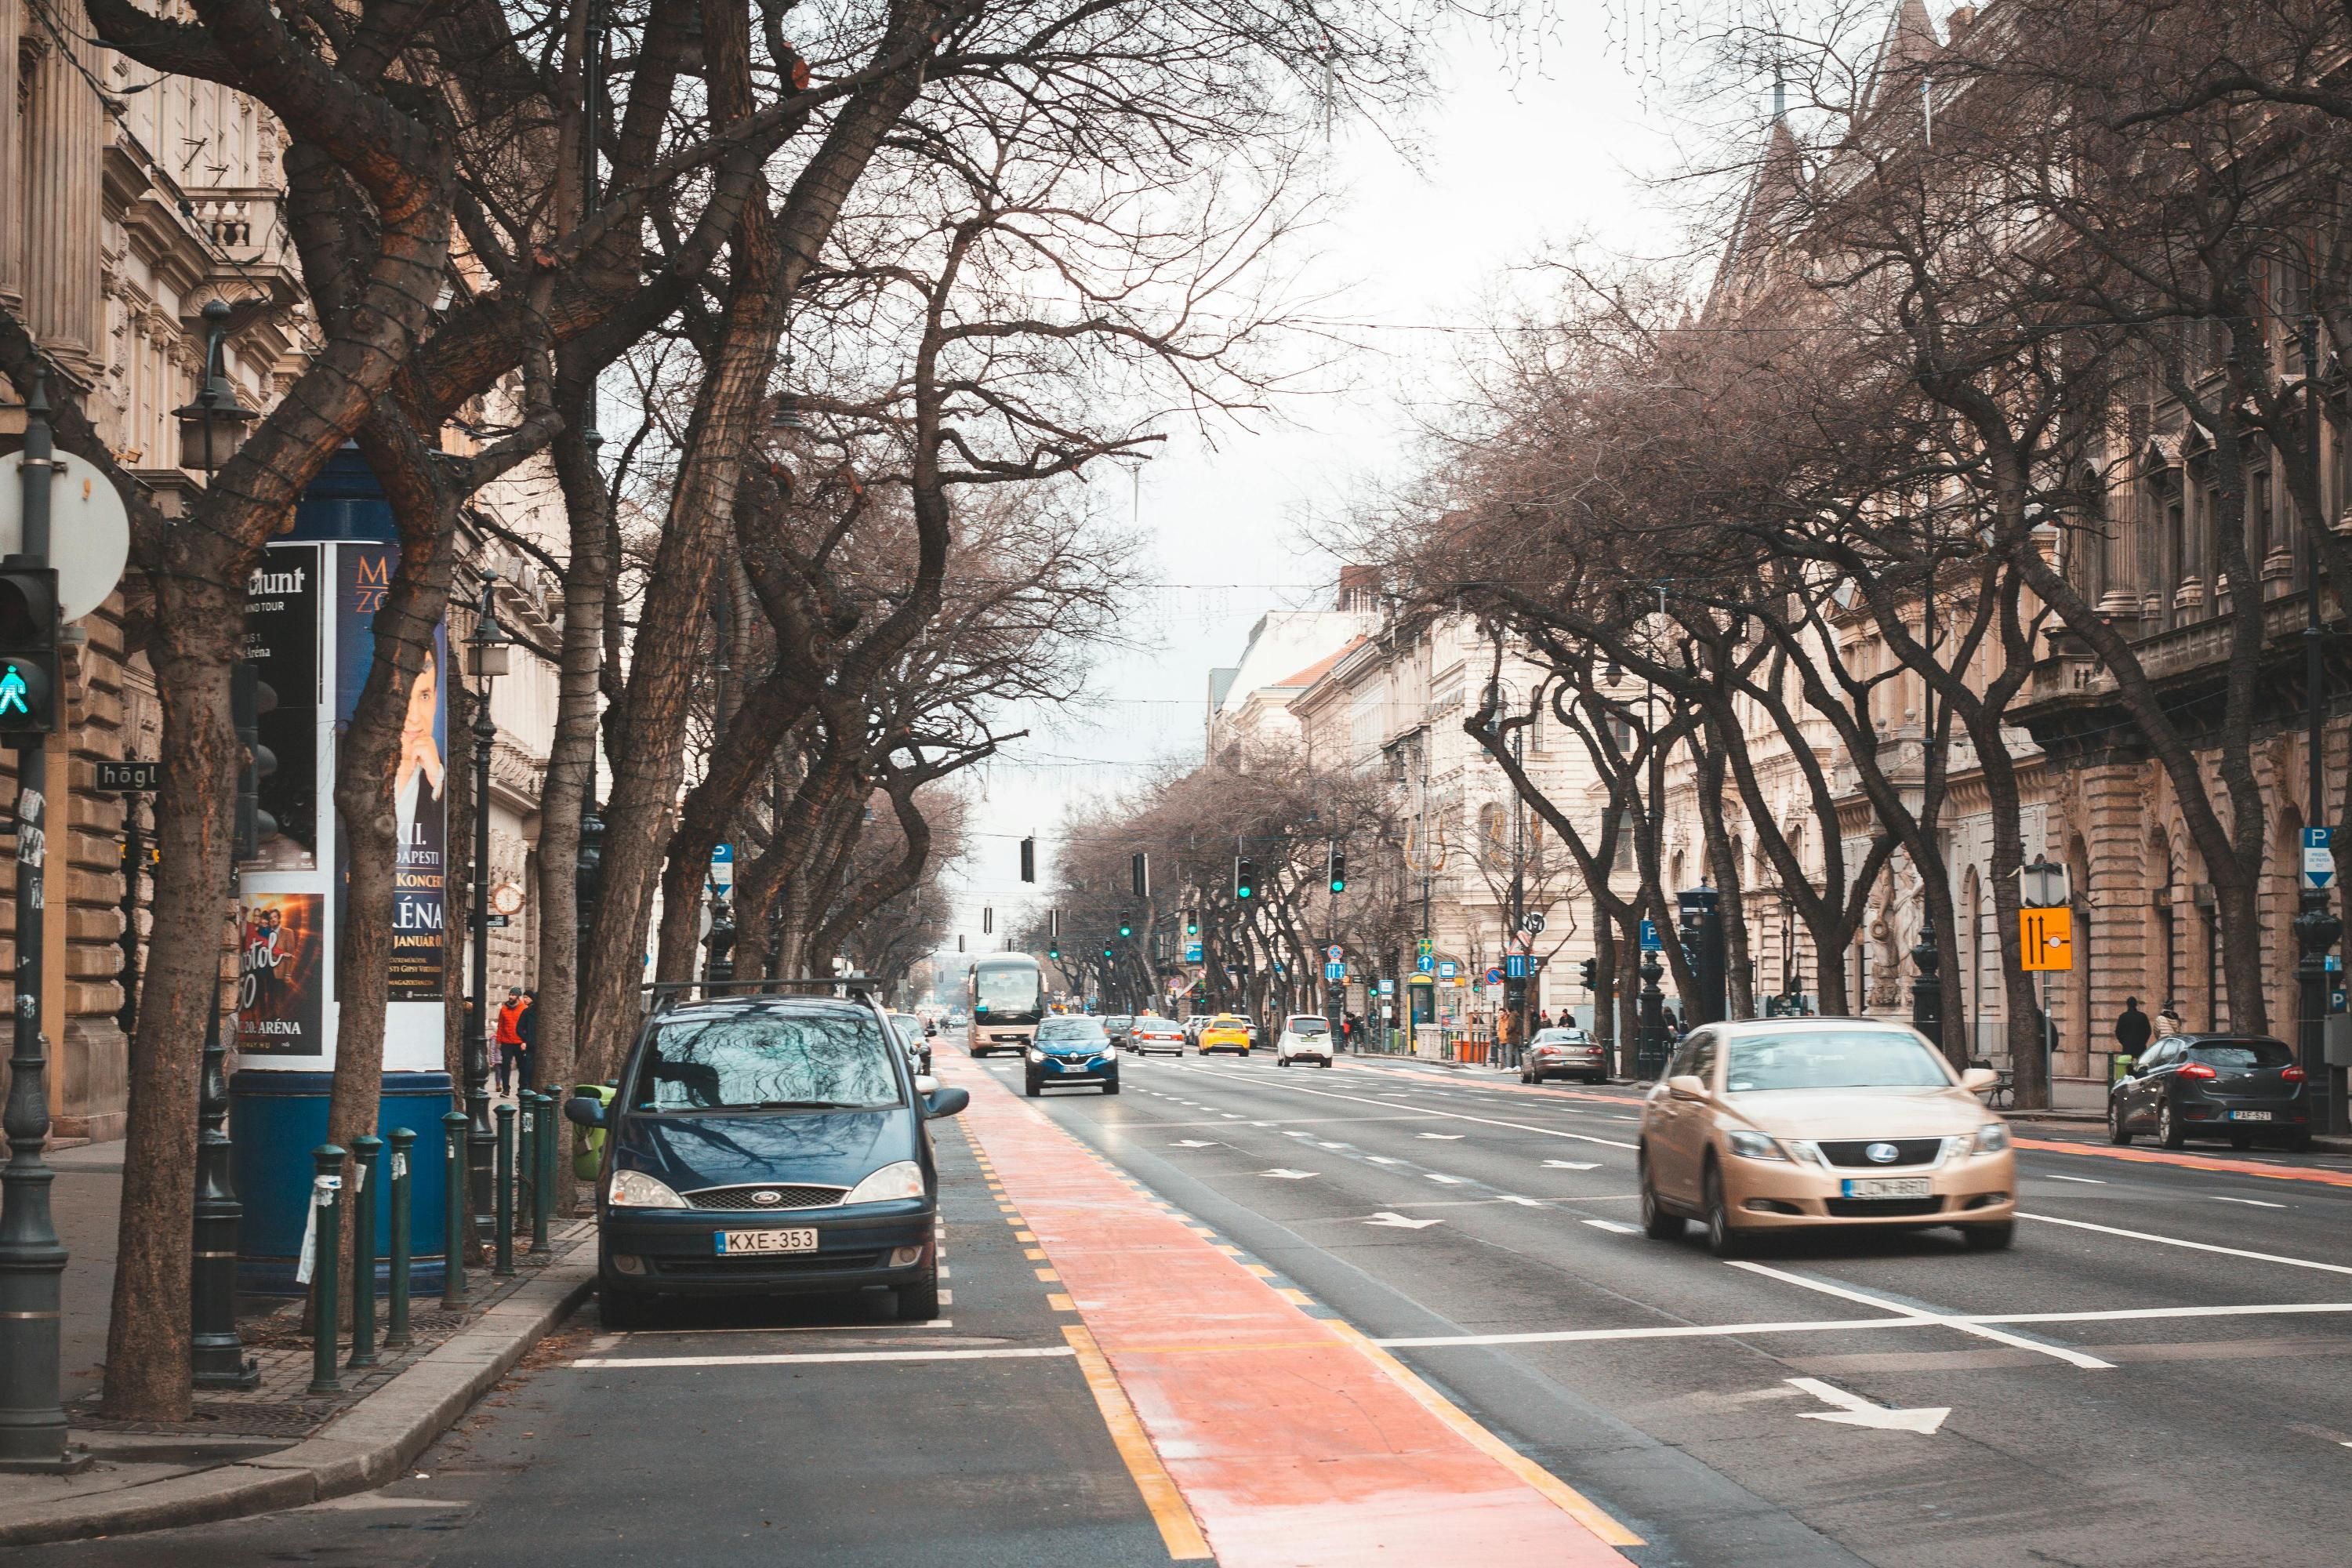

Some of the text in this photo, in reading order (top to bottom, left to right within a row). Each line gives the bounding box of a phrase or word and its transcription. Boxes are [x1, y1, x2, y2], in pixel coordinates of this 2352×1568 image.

[261, 601, 285, 612] TOUR
[2311, 829, 2328, 847] P
[392, 895, 444, 929] ÉNA
[2332, 993, 2344, 1007] P
[258, 1018, 302, 1035] ARÉNA
[729, 1231, 813, 1250] KXE-353
